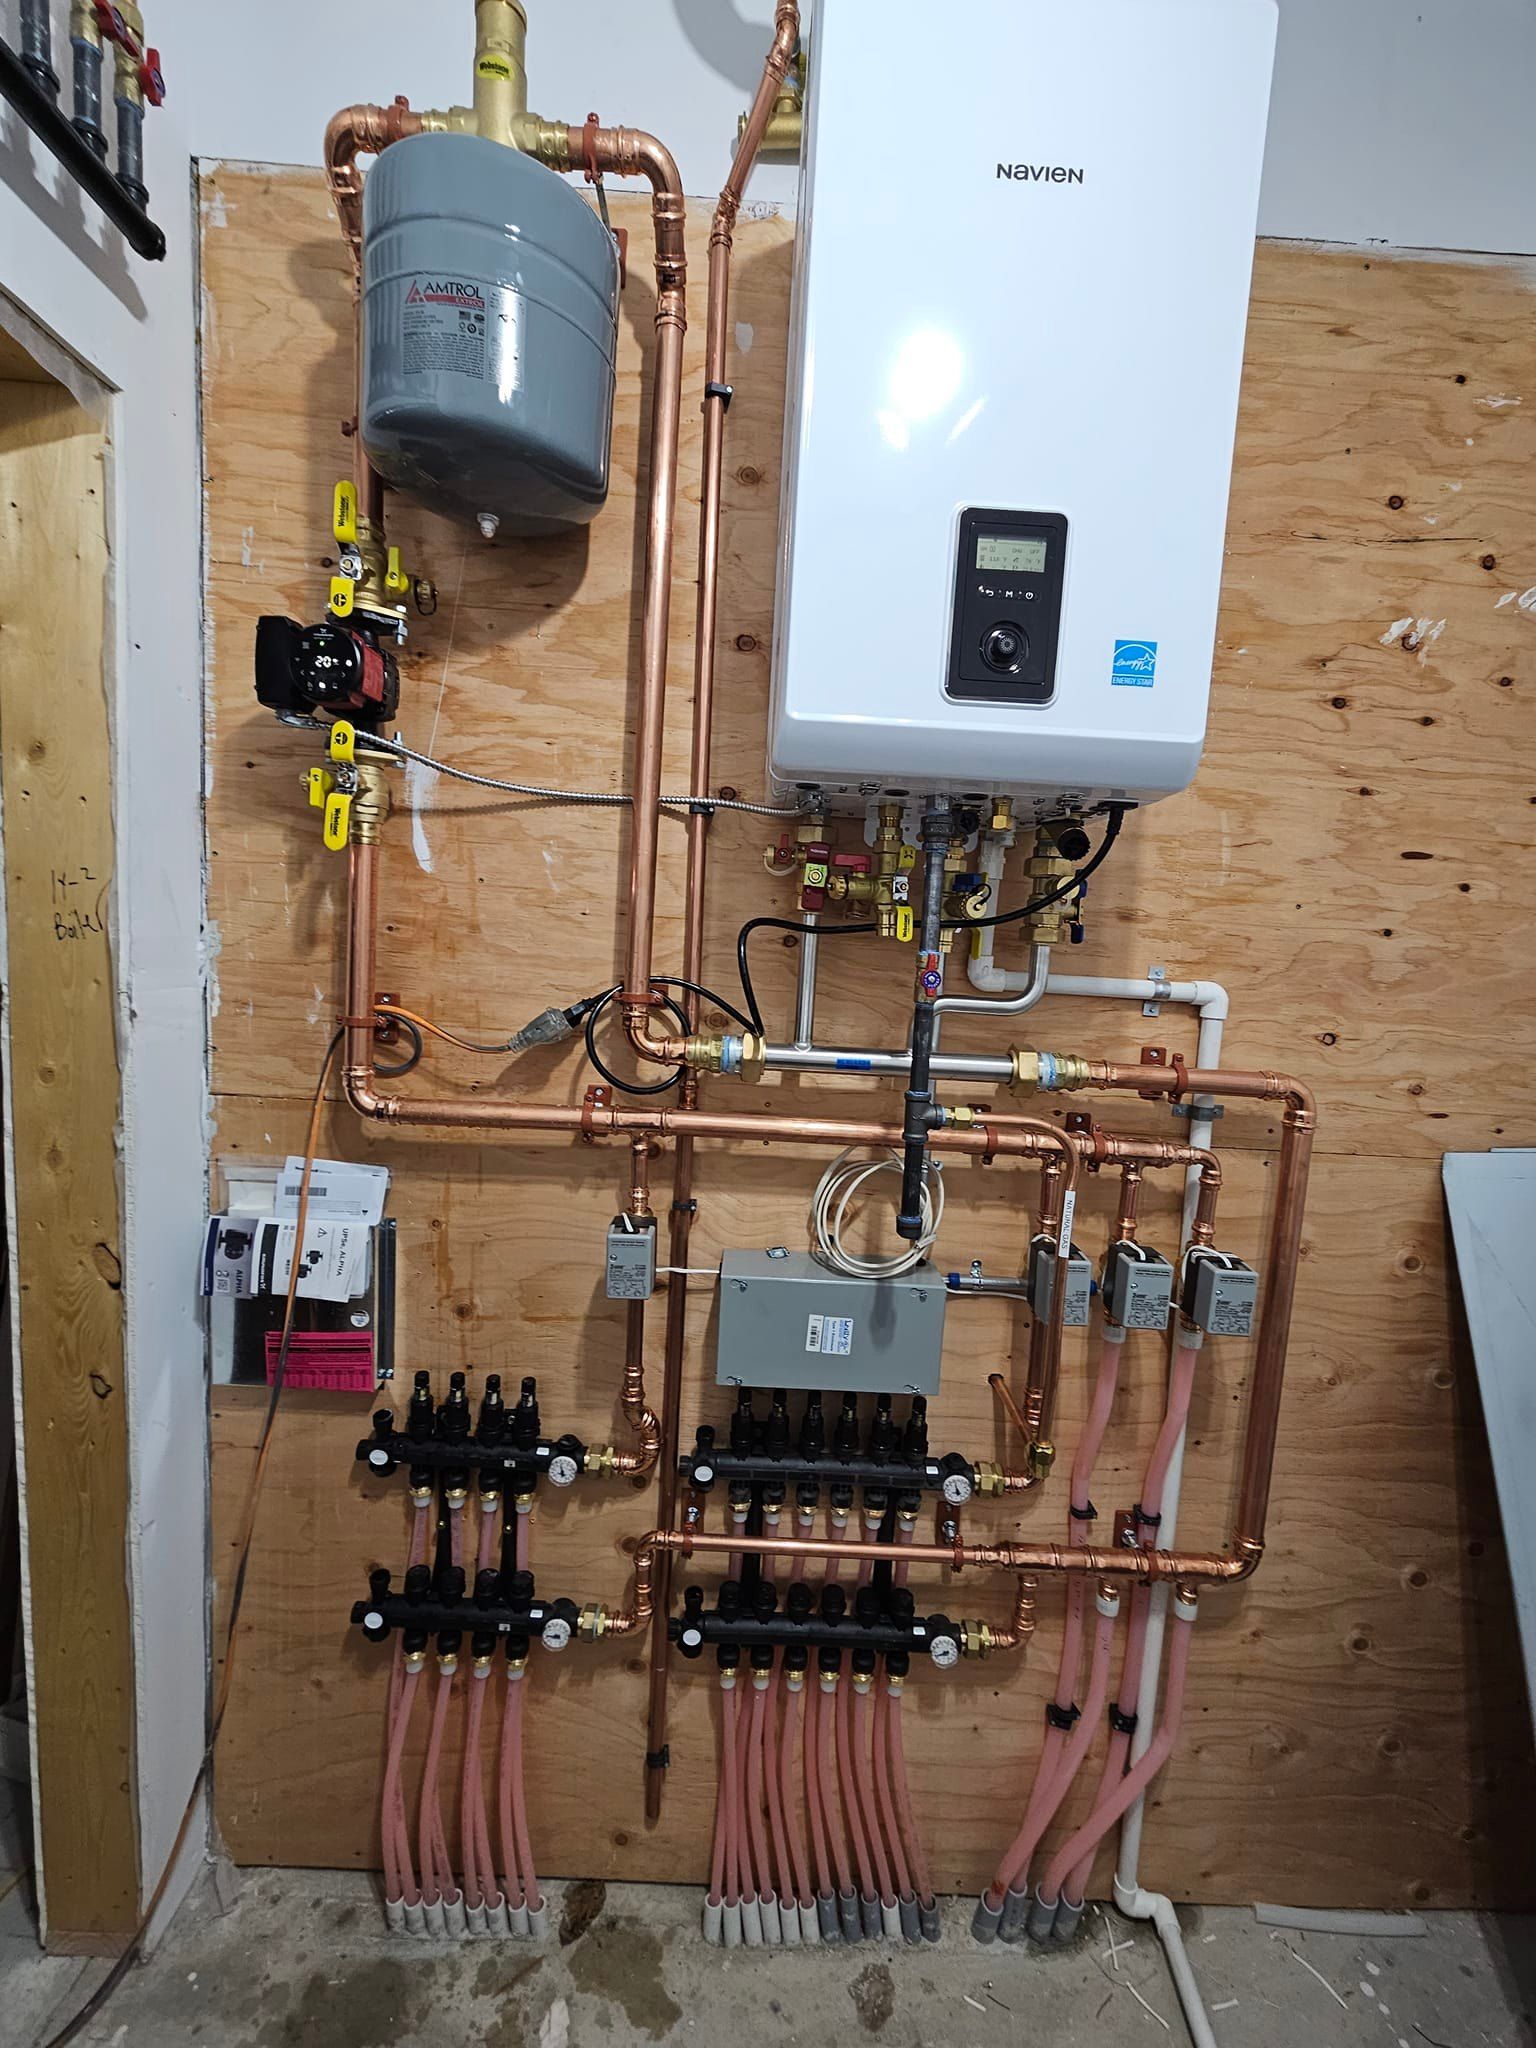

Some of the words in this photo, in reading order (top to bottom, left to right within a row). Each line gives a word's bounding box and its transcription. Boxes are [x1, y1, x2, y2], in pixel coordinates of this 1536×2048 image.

[423, 281, 485, 299] AMTROL
[1112, 676, 1136, 686] ENERGY
[1136, 678, 1153, 687] STAR
[1063, 1200, 1073, 1232] NATURAL
[1061, 1234, 1069, 1249] GAS
[336, 1250, 346, 1277] ALPHA
[235, 1269, 244, 1294] ALPHA
